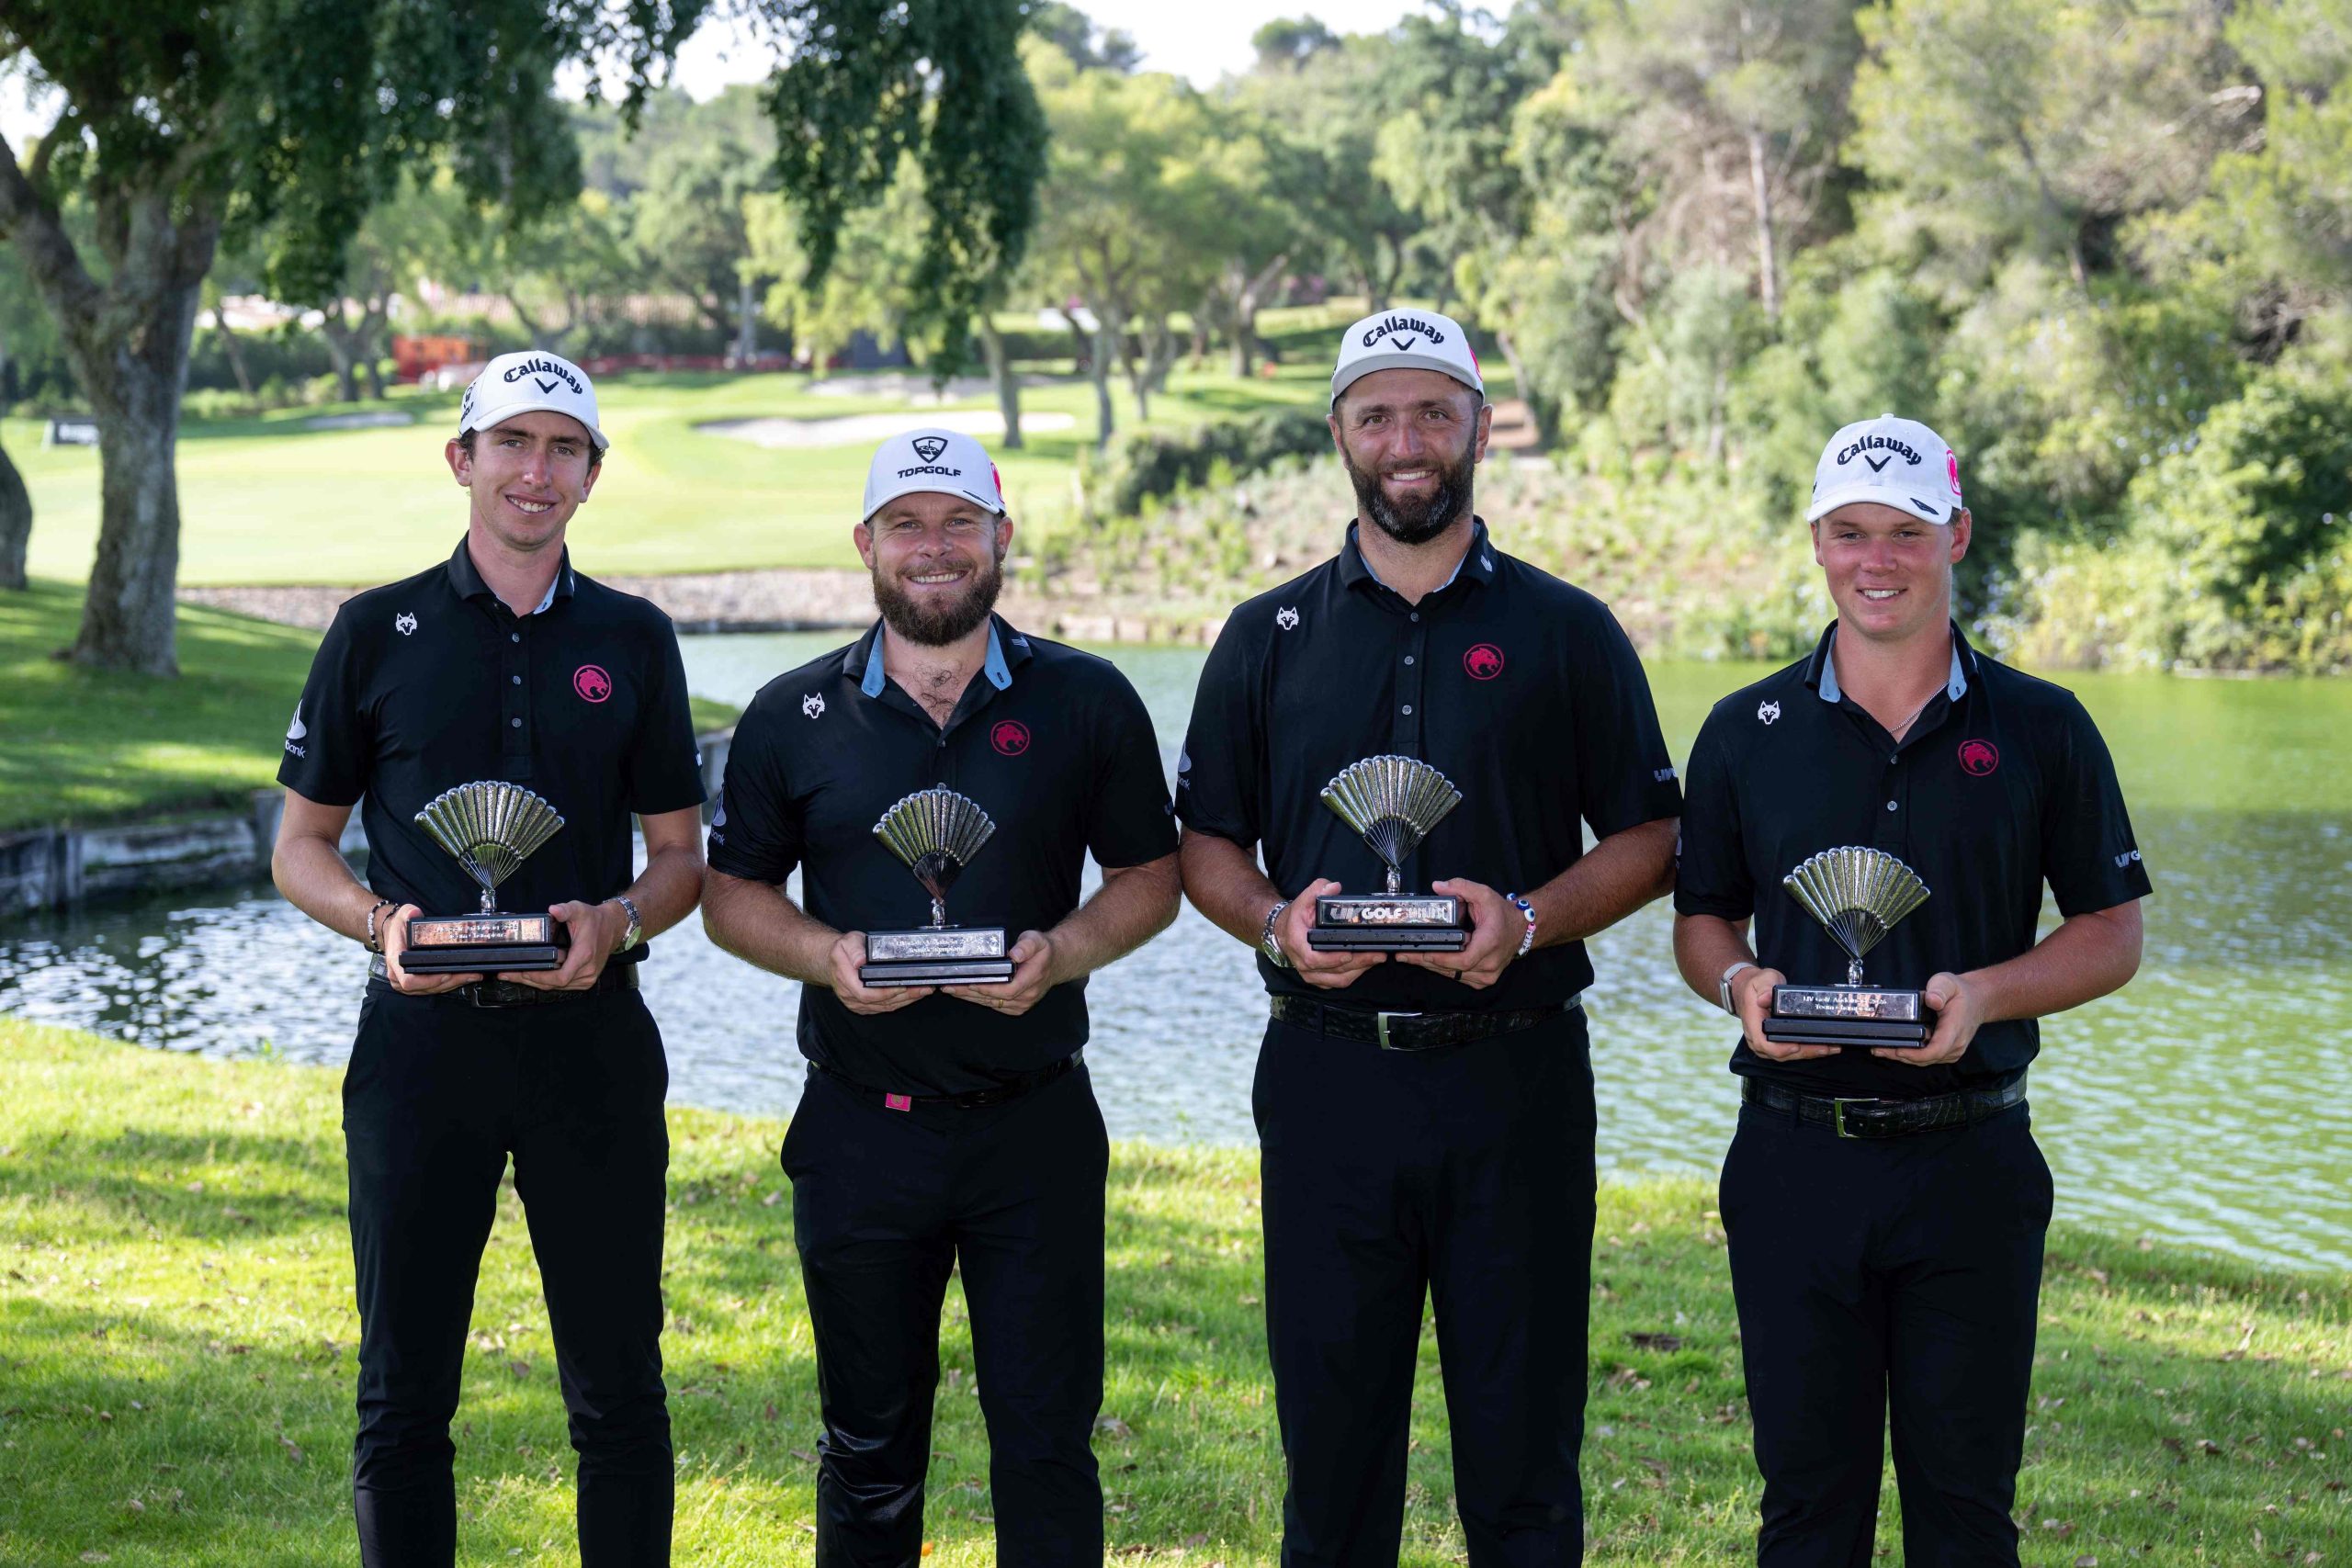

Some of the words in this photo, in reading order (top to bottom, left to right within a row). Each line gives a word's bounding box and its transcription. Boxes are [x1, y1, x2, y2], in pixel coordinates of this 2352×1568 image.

[1363, 315, 1445, 348] Callaway
[503, 357, 583, 395] Callaway
[1837, 434, 1923, 466] Callaway
[897, 466, 962, 479] TOPGOLF
[1361, 908, 1402, 919] GOLF
